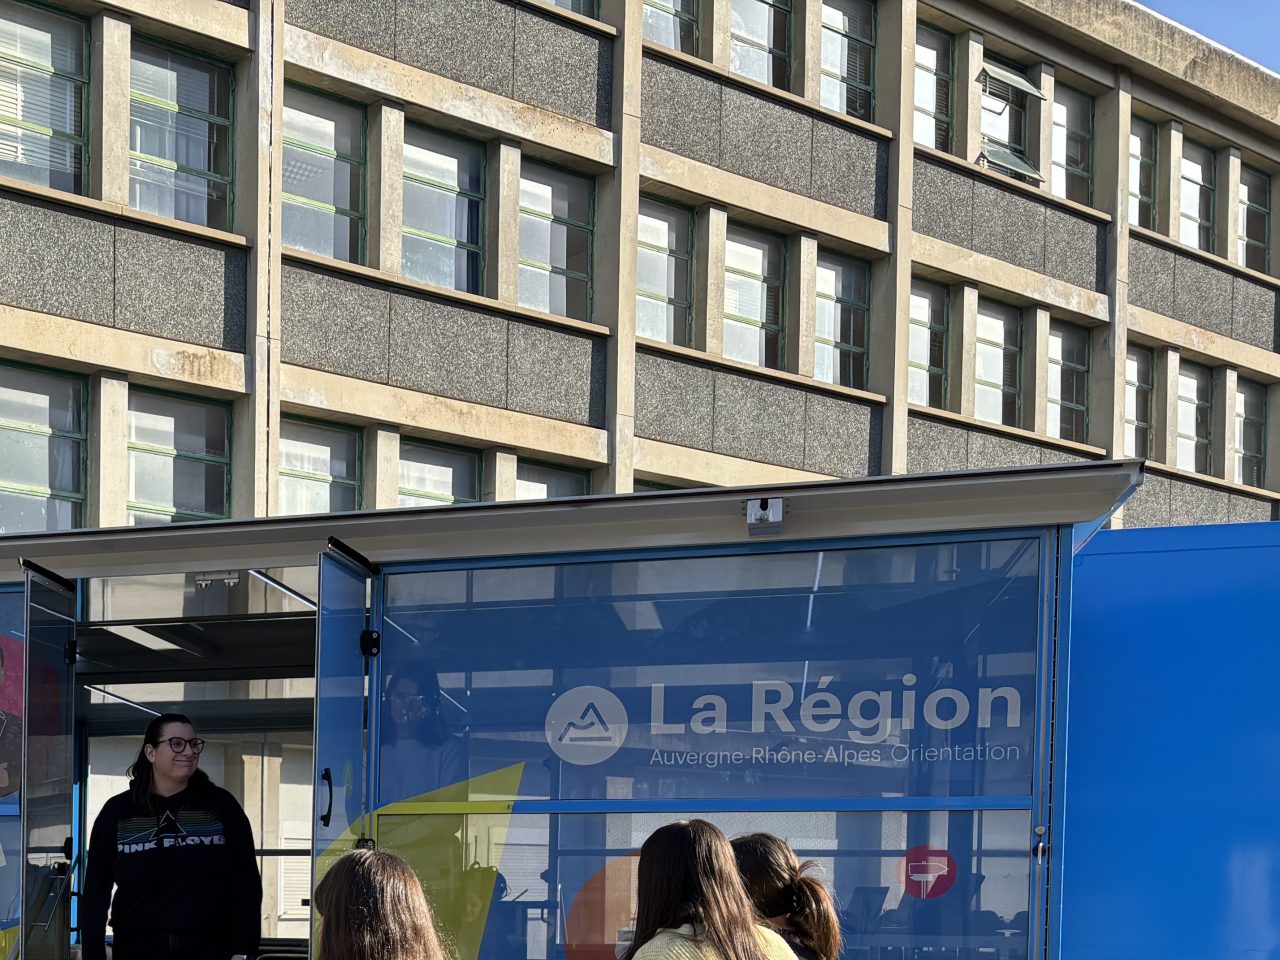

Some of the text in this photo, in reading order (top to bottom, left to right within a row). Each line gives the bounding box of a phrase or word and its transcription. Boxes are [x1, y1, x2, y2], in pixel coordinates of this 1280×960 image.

[650, 673, 1021, 744] La Région
[650, 742, 1020, 768] Auvergne-Rhône-Alpes Orientation
[117, 840, 158, 853] PINK
